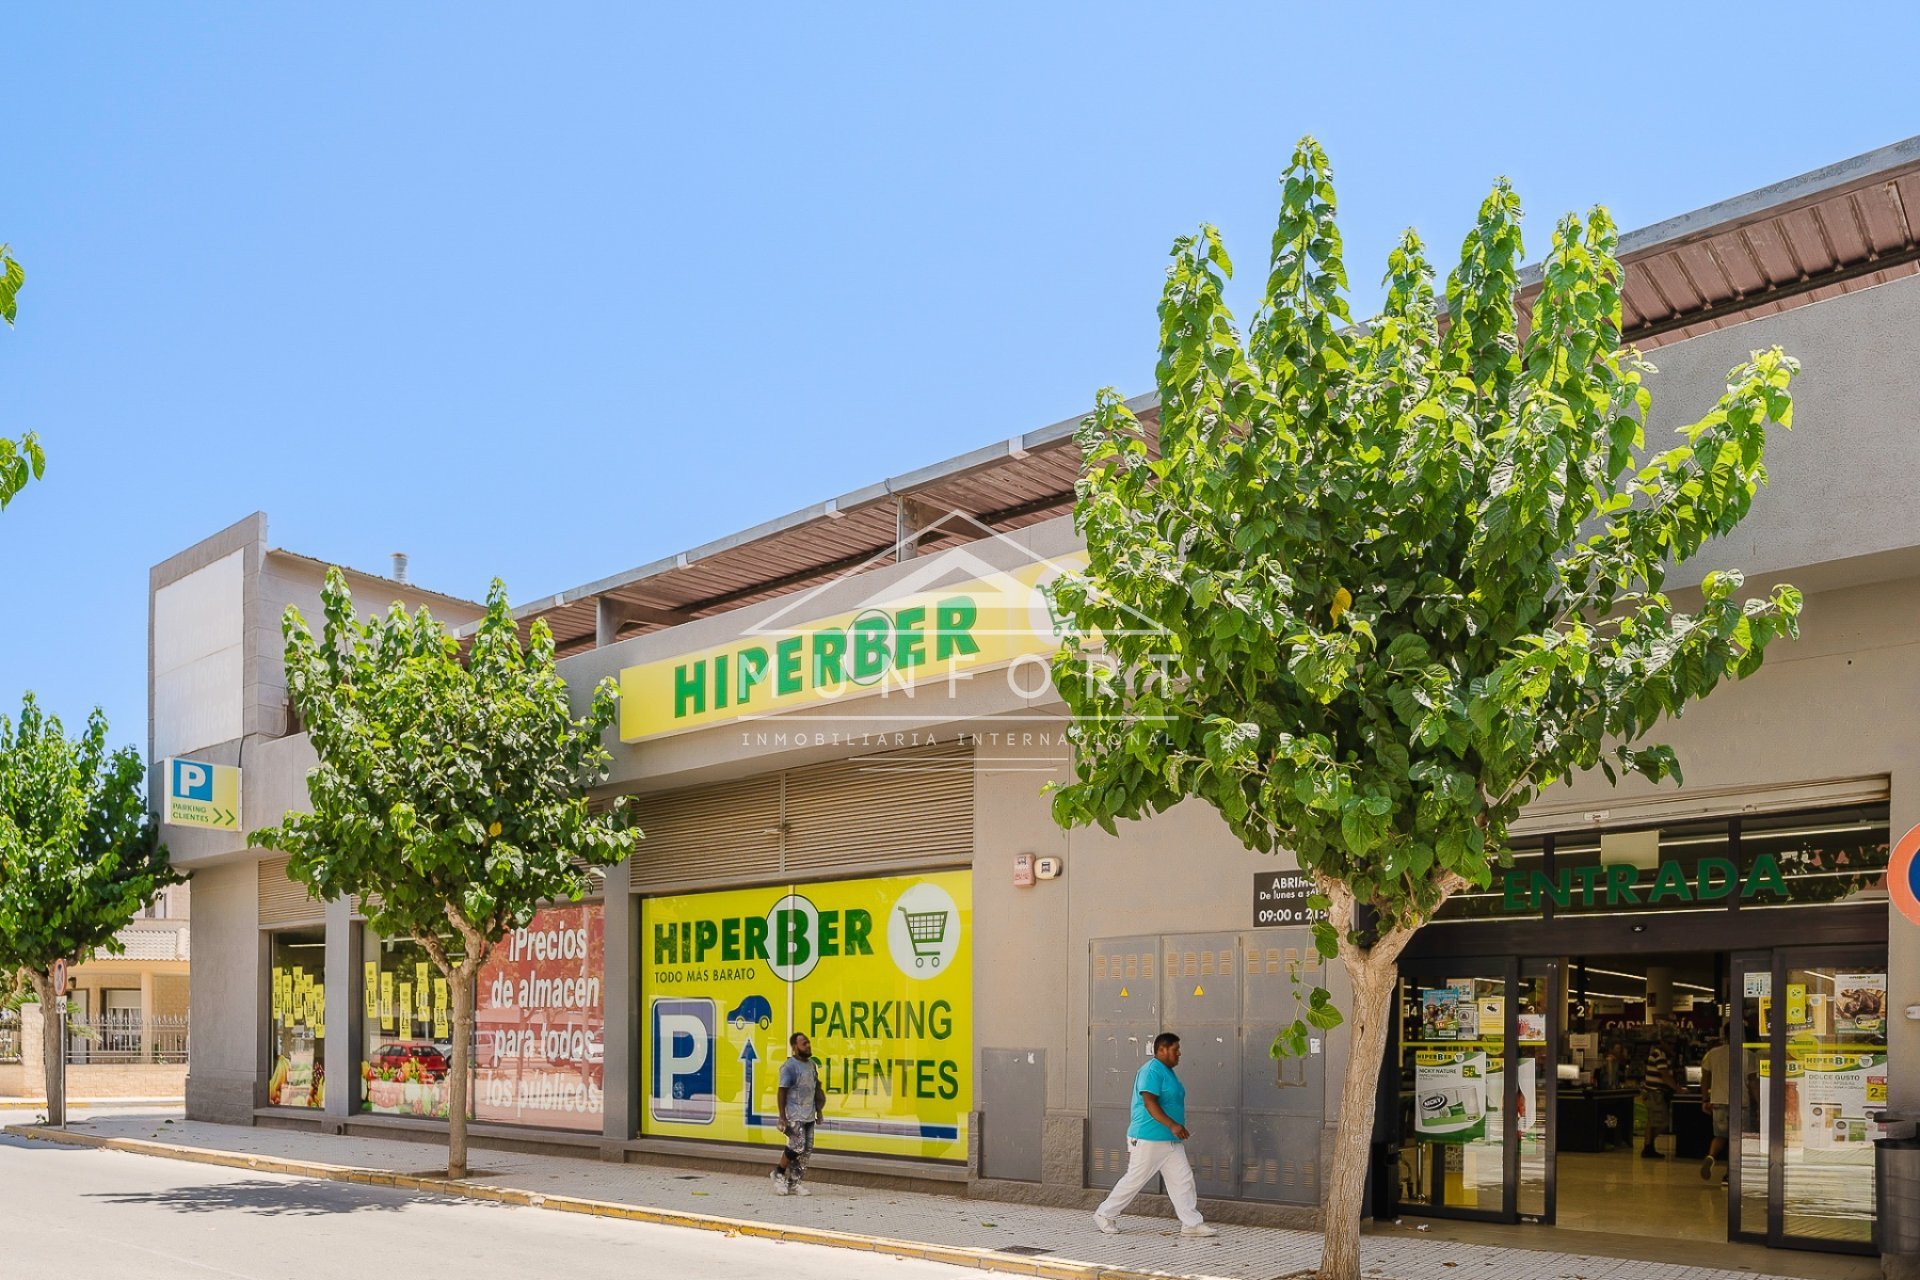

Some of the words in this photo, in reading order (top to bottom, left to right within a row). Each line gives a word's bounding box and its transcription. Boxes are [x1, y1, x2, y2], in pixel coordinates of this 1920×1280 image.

[674, 595, 980, 719] HIPERBER
[180, 763, 206, 796] P
[172, 802, 207, 813] PARKING
[172, 811, 209, 823] CLIENTES
[1259, 891, 1271, 900] De
[1273, 889, 1296, 899] lunes
[1297, 890, 1304, 898] a
[1503, 852, 1790, 911] ENTRADA
[1258, 908, 1292, 922] 09:00
[1294, 911, 1302, 920] a
[508, 920, 587, 962] ¡Precios
[654, 908, 875, 967] HIPERBER
[491, 971, 514, 1009] de
[518, 966, 600, 1009] almacén
[654, 971, 683, 983] TODO
[686, 966, 709, 982] MÁS
[713, 967, 755, 981] BARATO
[811, 1000, 952, 1040] PARKING
[1576, 1005, 1585, 1017] 2
[494, 1028, 535, 1068] para
[540, 1021, 595, 1062] todos
[659, 1014, 708, 1110] P
[484, 1069, 513, 1107] los
[810, 1056, 959, 1100] LIENTES
